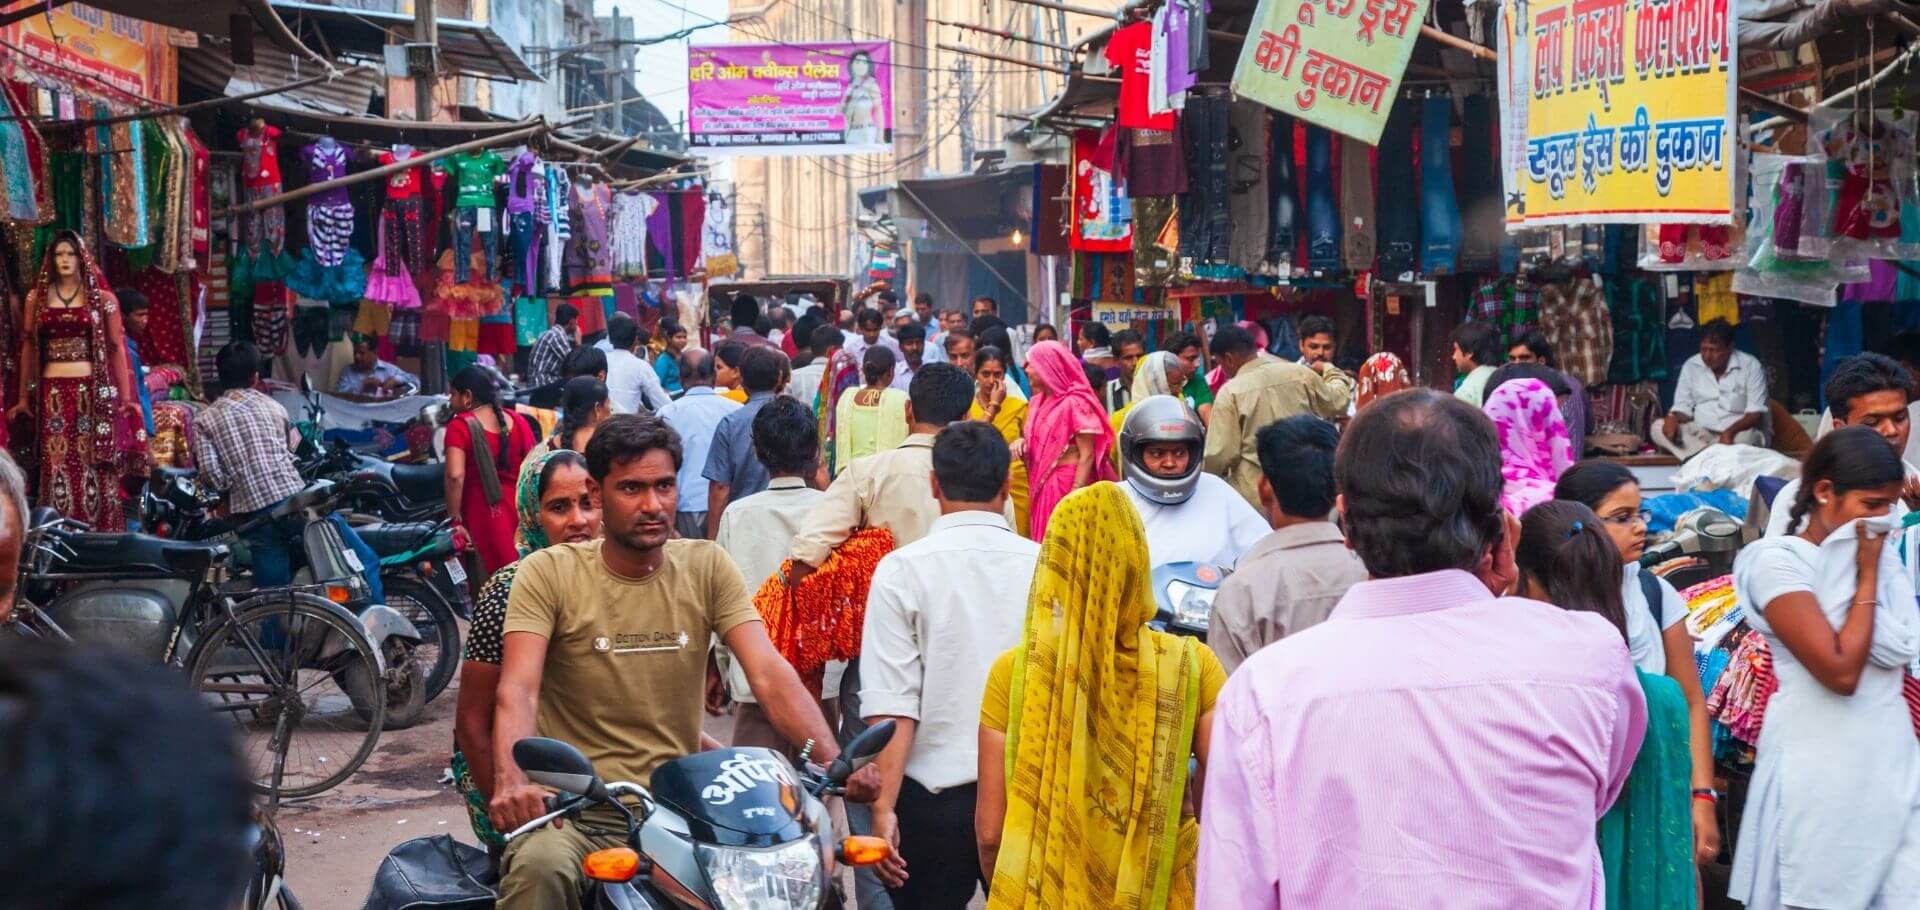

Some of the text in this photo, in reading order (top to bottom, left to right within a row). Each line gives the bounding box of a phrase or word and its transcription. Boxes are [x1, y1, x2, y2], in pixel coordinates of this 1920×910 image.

[1358, 0, 1417, 46] ड्रस
[1533, 6, 1568, 97] लव
[1633, 0, 1730, 81] कलक्शन
[690, 62, 714, 81] हरि
[717, 61, 748, 80] ओम
[1255, 23, 1392, 114] की दुकान
[1528, 131, 1578, 199] स्कूल
[1619, 105, 1651, 172] की
[1655, 119, 1726, 196] दुकान
[742, 807, 776, 818] TVS
